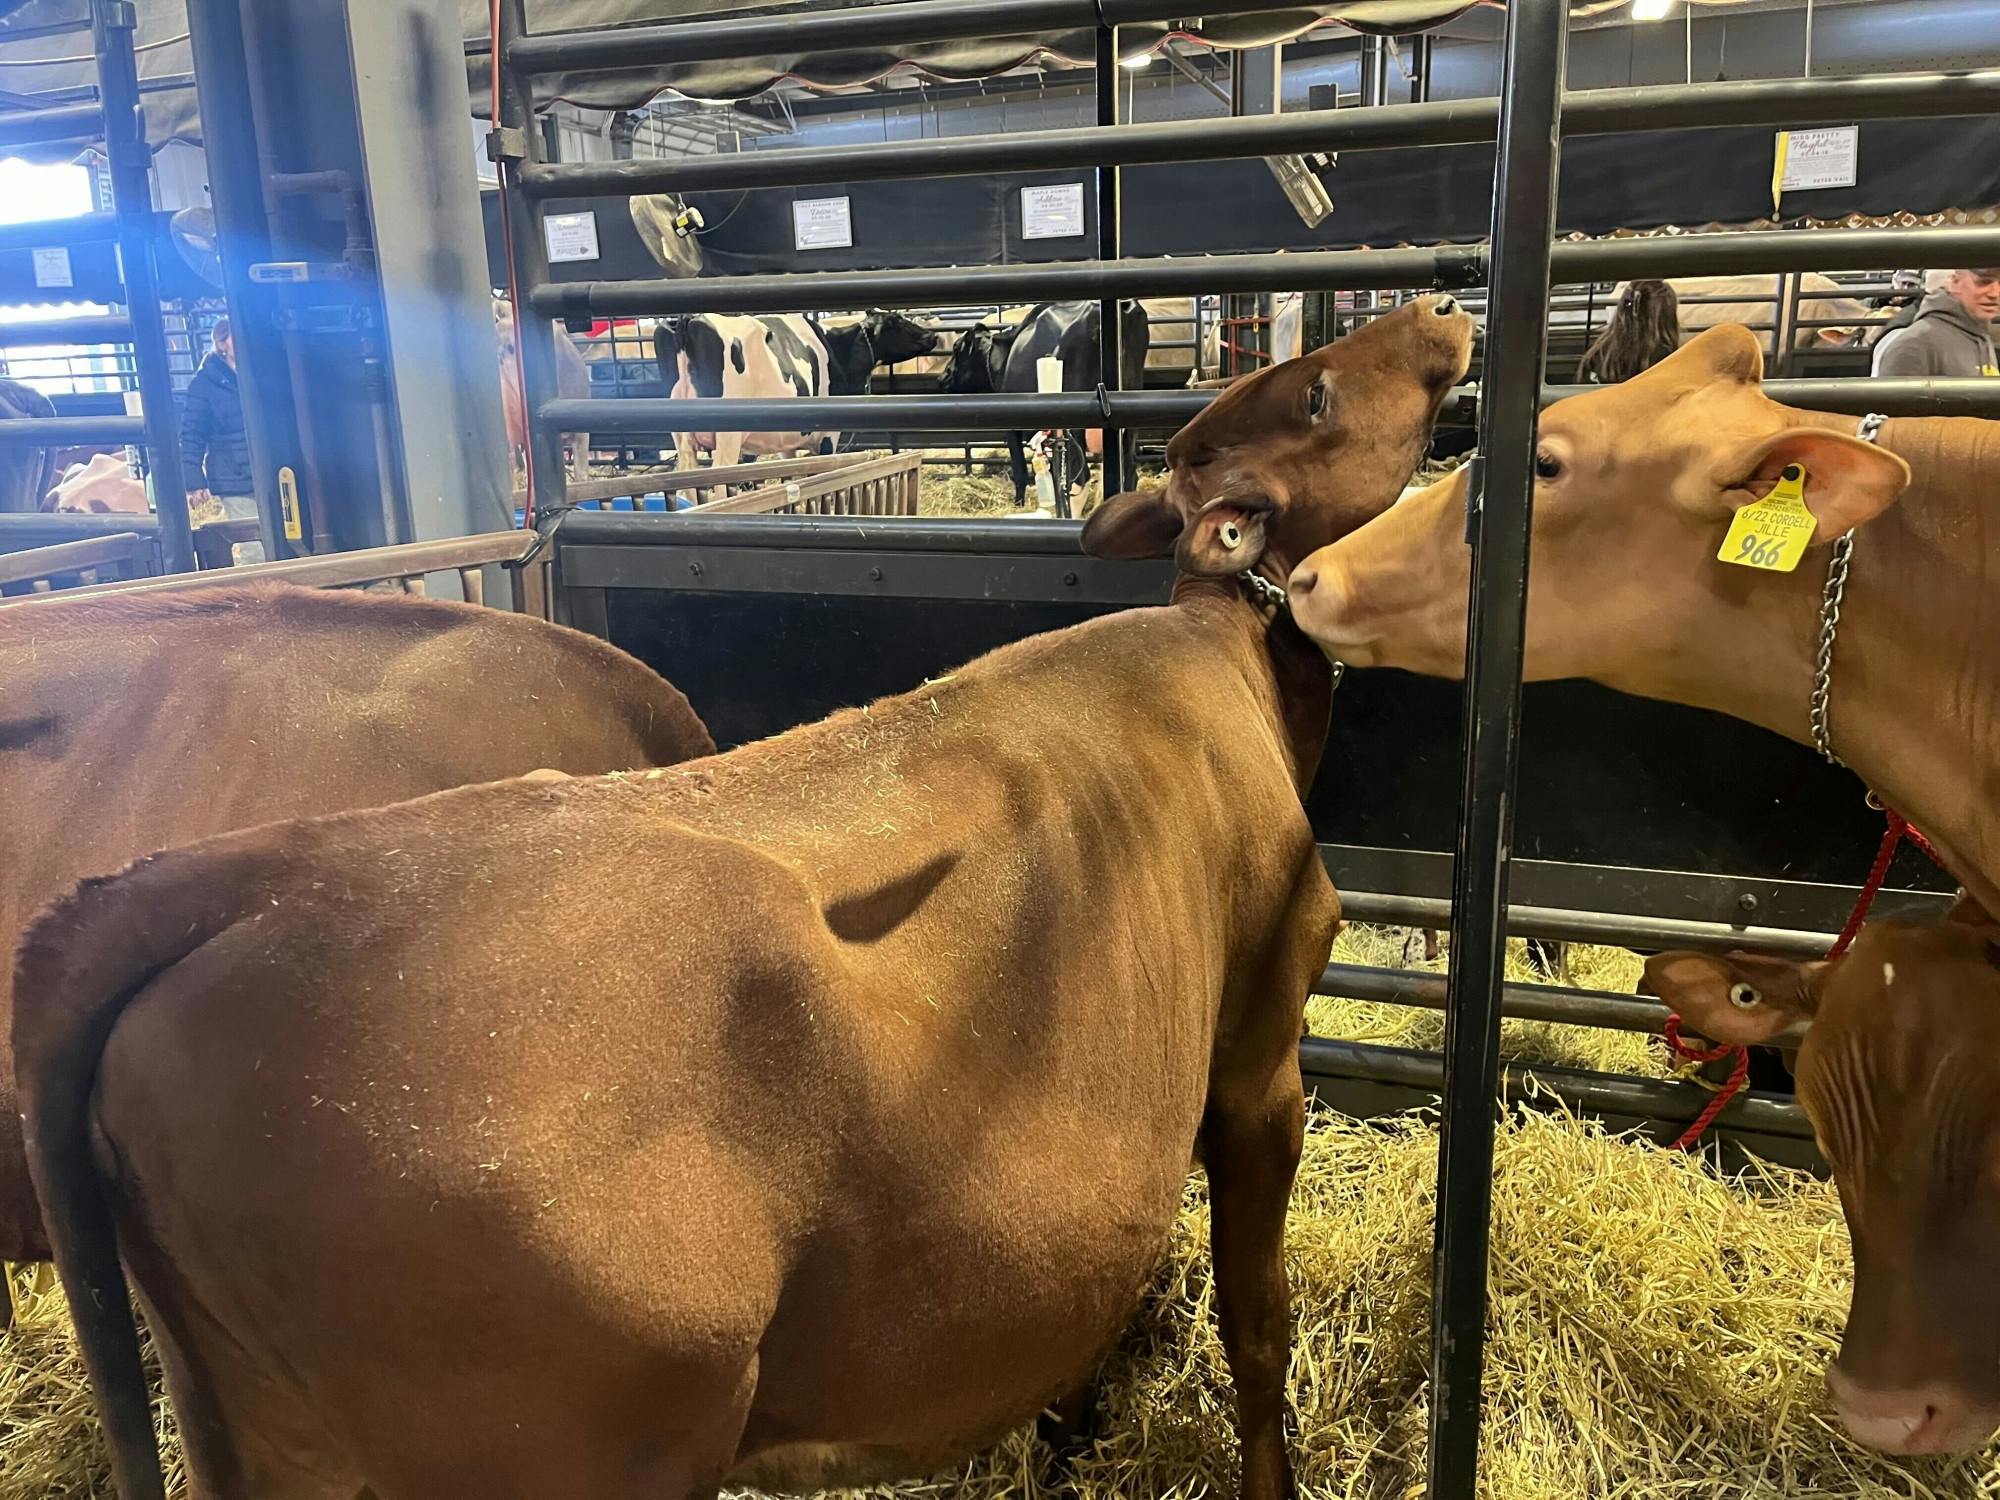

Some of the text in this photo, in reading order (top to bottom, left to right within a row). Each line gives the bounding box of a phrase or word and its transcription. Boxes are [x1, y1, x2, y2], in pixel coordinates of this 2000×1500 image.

[1741, 508, 1769, 522] 6/22
[1769, 512, 1811, 529] CORDELL
[1754, 523, 1791, 538] JILLE
[1734, 534, 1788, 567] 966
